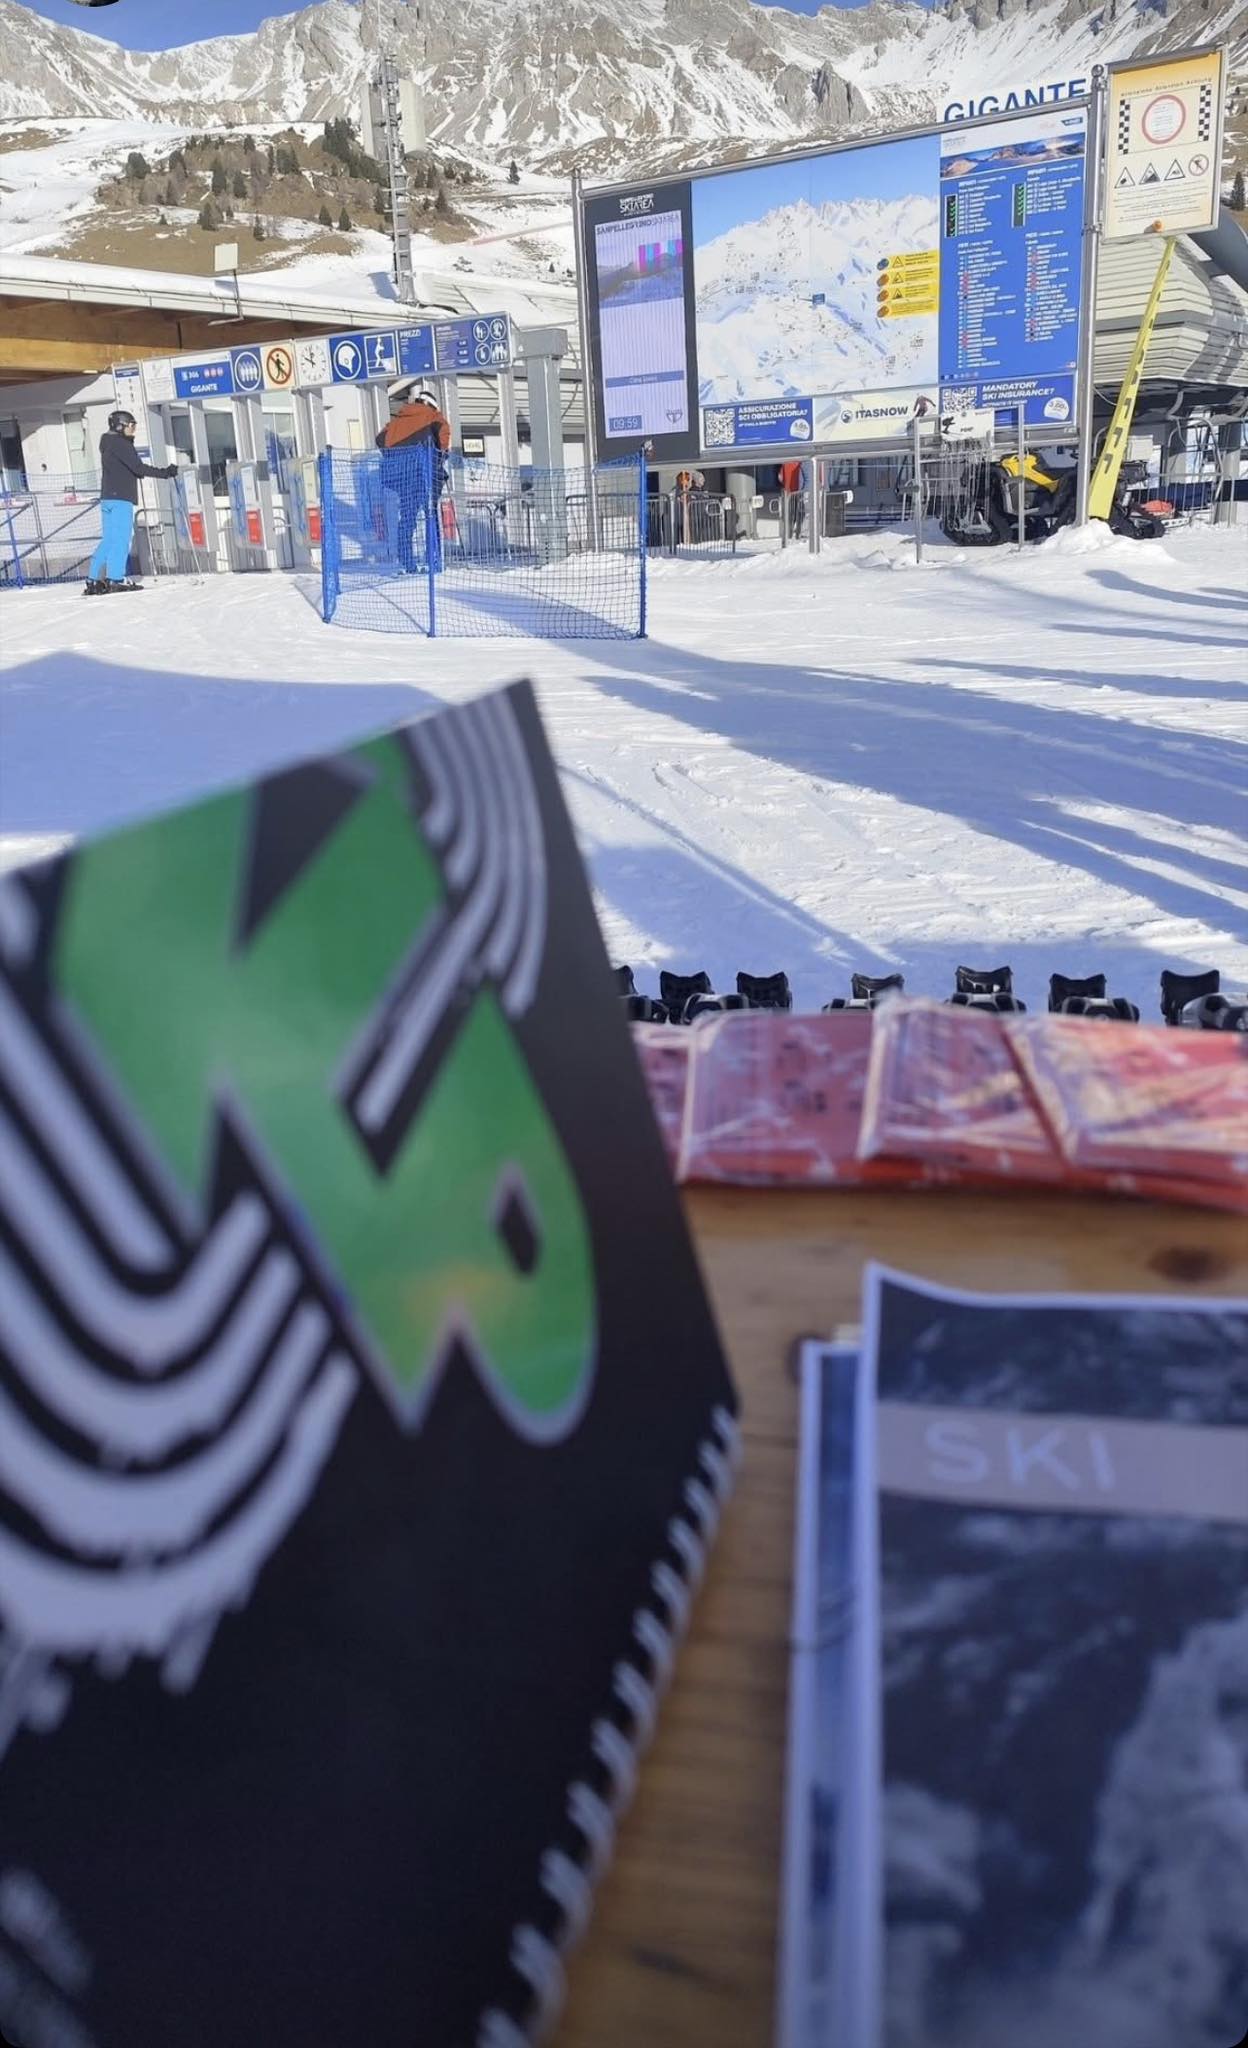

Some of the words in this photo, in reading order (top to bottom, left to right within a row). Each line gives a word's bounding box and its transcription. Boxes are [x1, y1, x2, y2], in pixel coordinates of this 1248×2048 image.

[944, 78, 1087, 122] GIGANTE
[190, 383, 218, 394] GIGANTE
[982, 381, 1038, 392] MANDATORY
[982, 392, 997, 401] SKI
[998, 388, 1055, 399] INSURANCE?
[738, 402, 797, 413] ASSICURAZIONE
[855, 406, 909, 420] ITASNOW
[925, 1421, 1117, 1490] SKI
